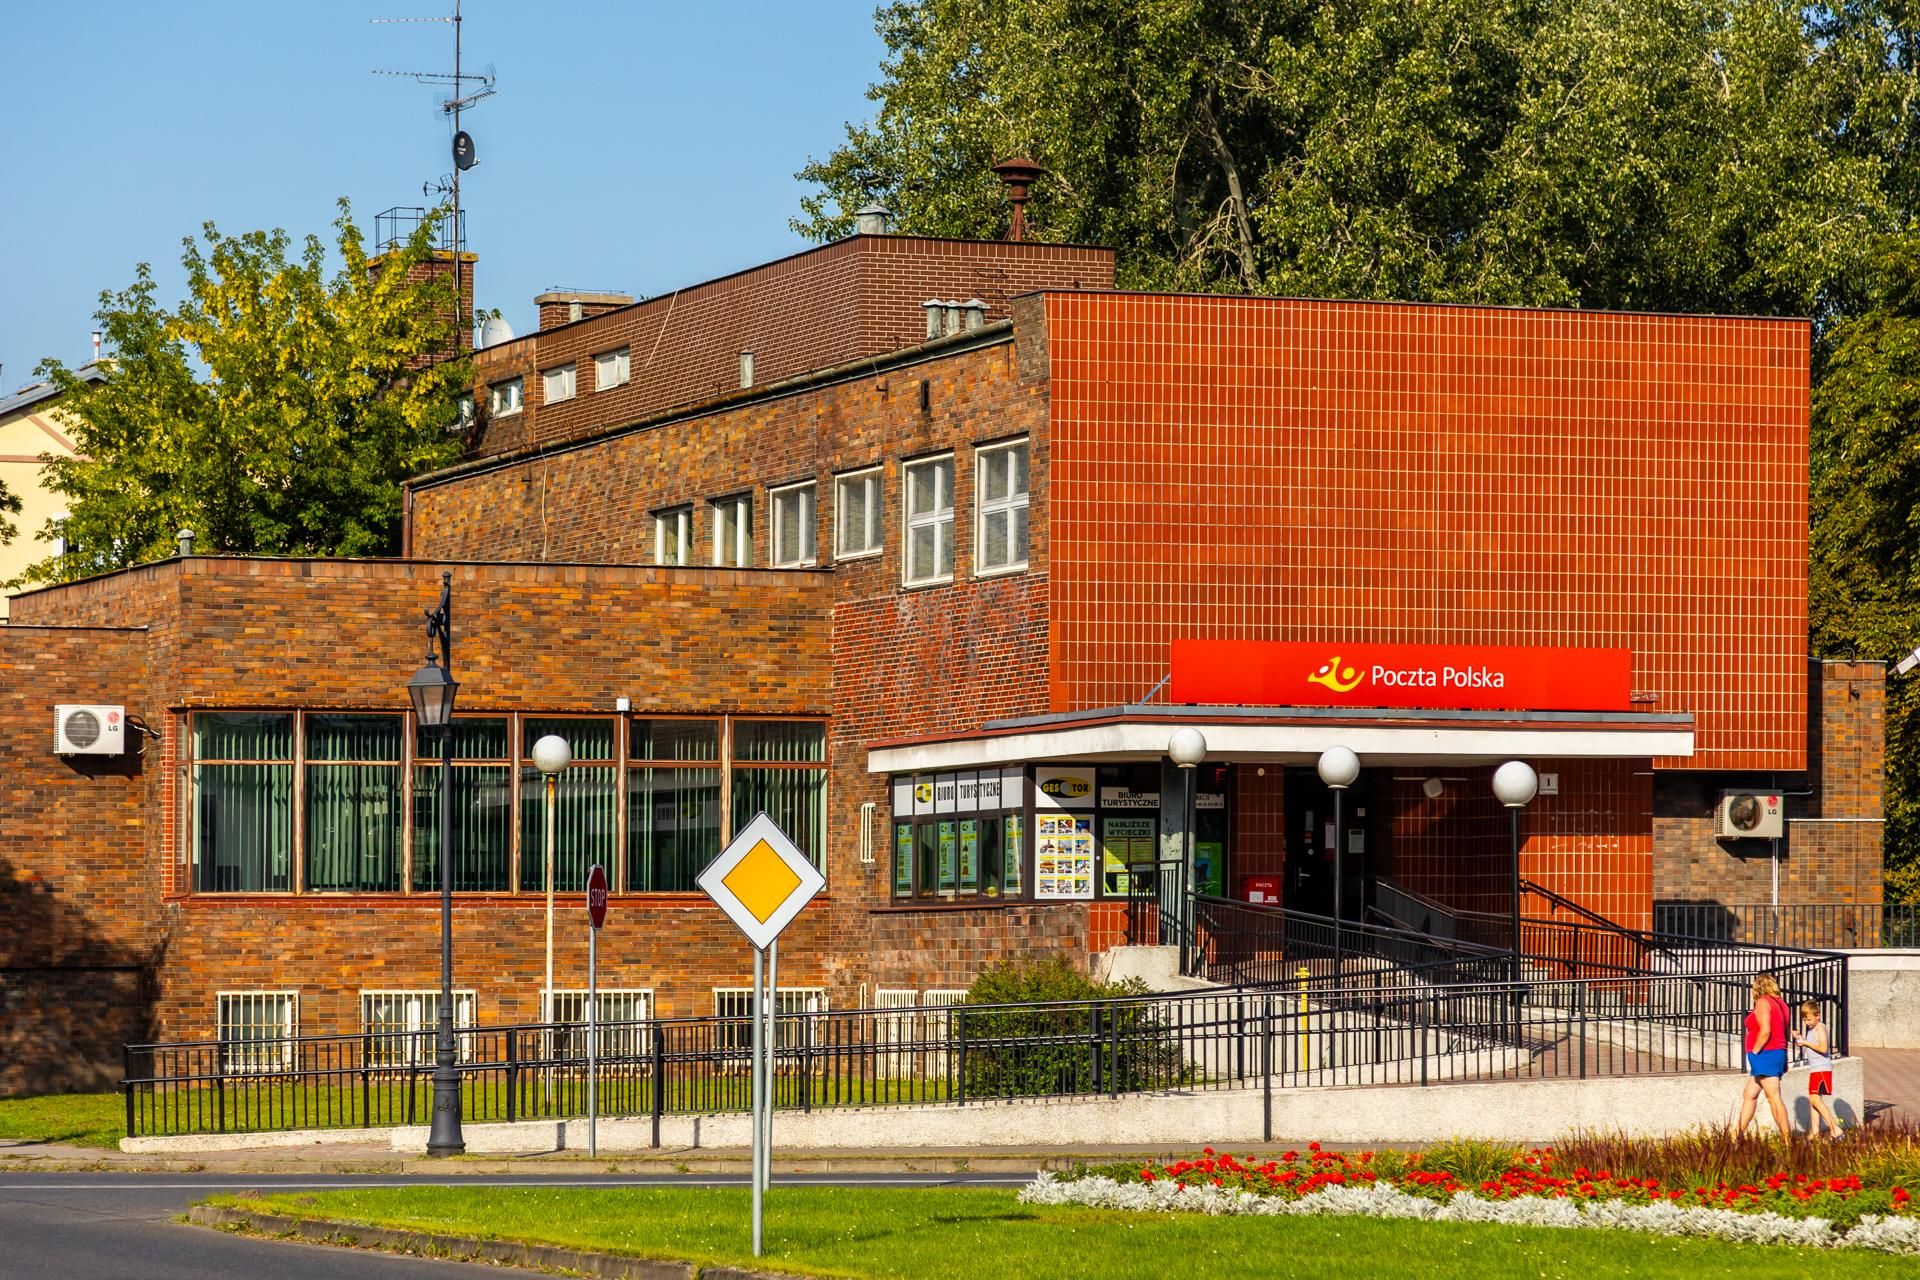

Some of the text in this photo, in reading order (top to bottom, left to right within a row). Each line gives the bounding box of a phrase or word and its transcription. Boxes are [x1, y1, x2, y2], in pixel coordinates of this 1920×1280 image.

[1372, 665, 1504, 688] Poczta Polska
[938, 786, 954, 801] BIURO
[960, 782, 1000, 799] TURYSTYCZNE
[1118, 791, 1143, 799] BIURO
[1102, 799, 1159, 807] TURYSTYCZNE
[590, 888, 606, 907] STOP
